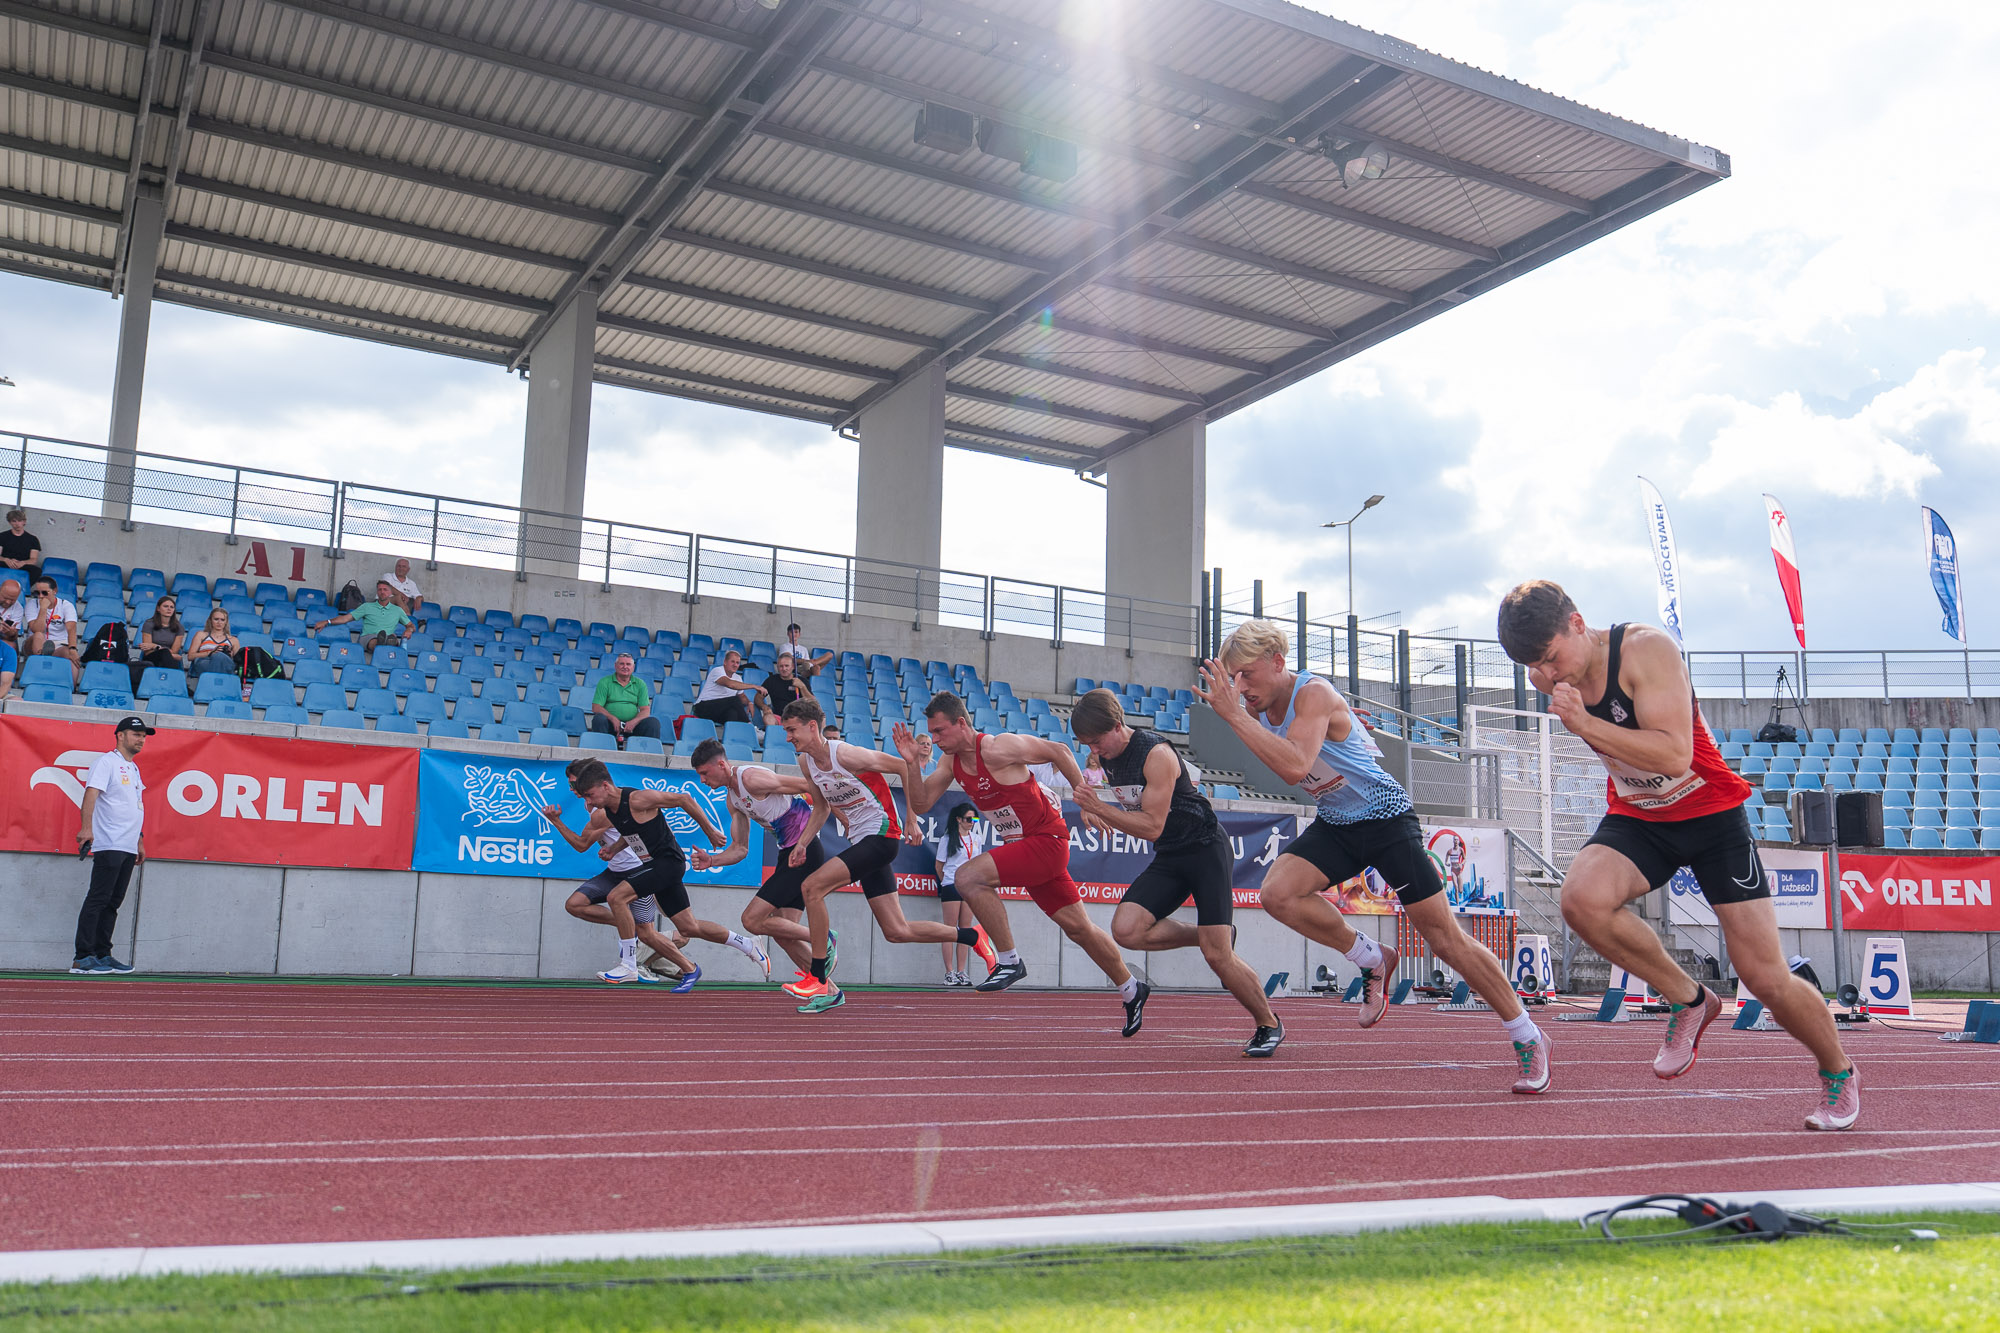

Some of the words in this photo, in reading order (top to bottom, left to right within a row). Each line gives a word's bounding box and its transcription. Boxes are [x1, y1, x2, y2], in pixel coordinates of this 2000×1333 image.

[166, 769, 384, 827] ORLEN
[993, 808, 1011, 819] 143
[995, 819, 1021, 832] ONKA
[1781, 873, 1794, 882] DLA
[1881, 876, 1992, 906] ORLEN
[1516, 946, 1535, 984] 8
[1541, 947, 1551, 986] 8
[1869, 953, 1899, 1000] 5
